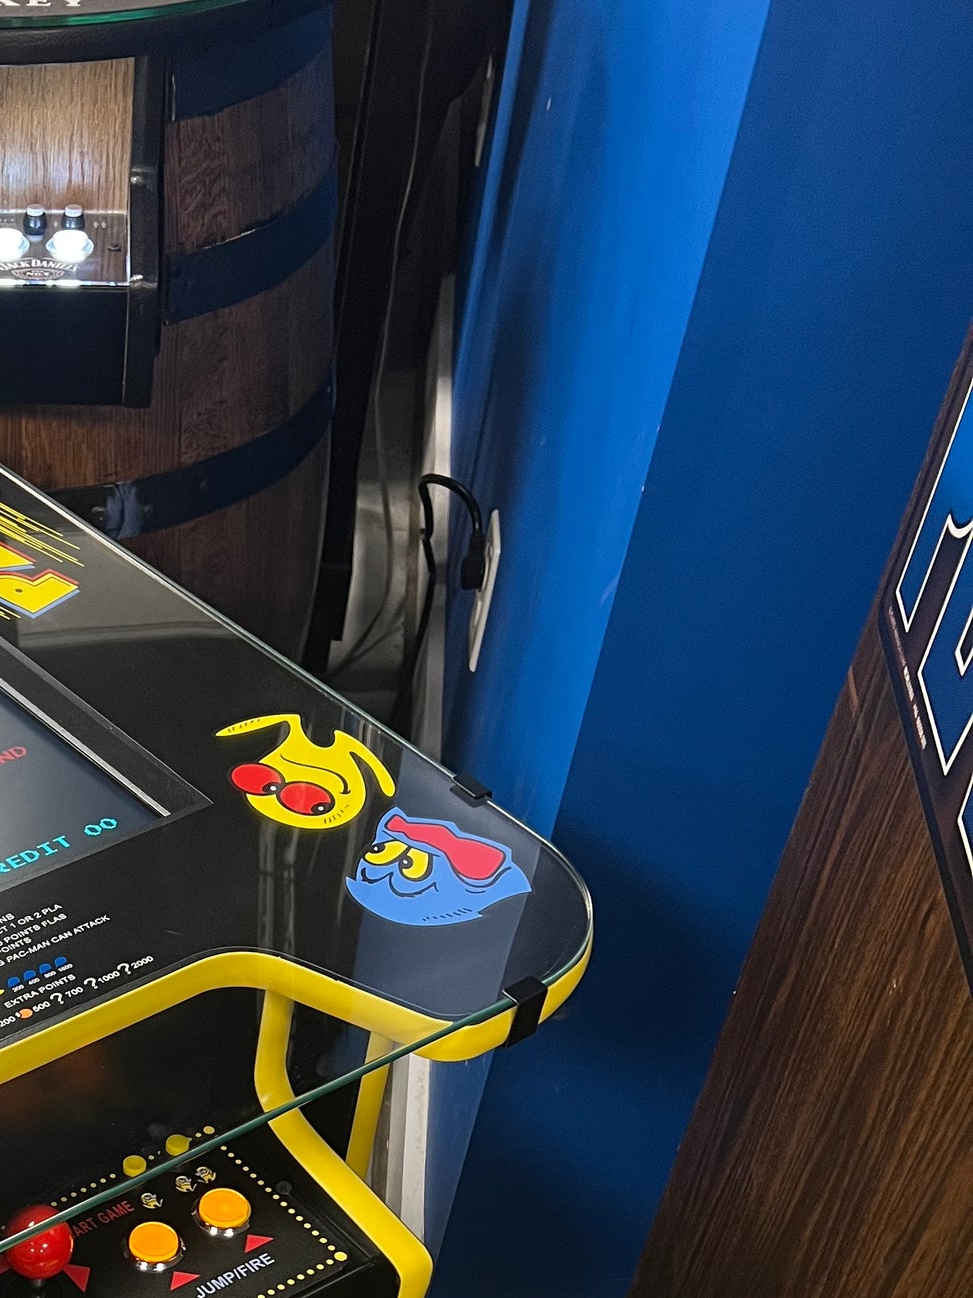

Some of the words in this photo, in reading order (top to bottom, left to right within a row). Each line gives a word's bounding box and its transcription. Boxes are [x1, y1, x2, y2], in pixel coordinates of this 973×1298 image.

[83, 817, 119, 837] 00
[17, 915, 34, 925] OR
[4, 924, 41, 943] POINTS
[6, 940, 51, 963] PAC-MAN
[51, 931, 73, 943] CAN
[73, 914, 111, 935] ATTACK
[65, 987, 84, 998] 700
[97, 970, 120, 984] 1000
[130, 955, 154, 969] 2000
[4, 990, 39, 1009] EXTRA
[41, 974, 76, 994] POINTS
[97, 1200, 135, 1224] GAME
